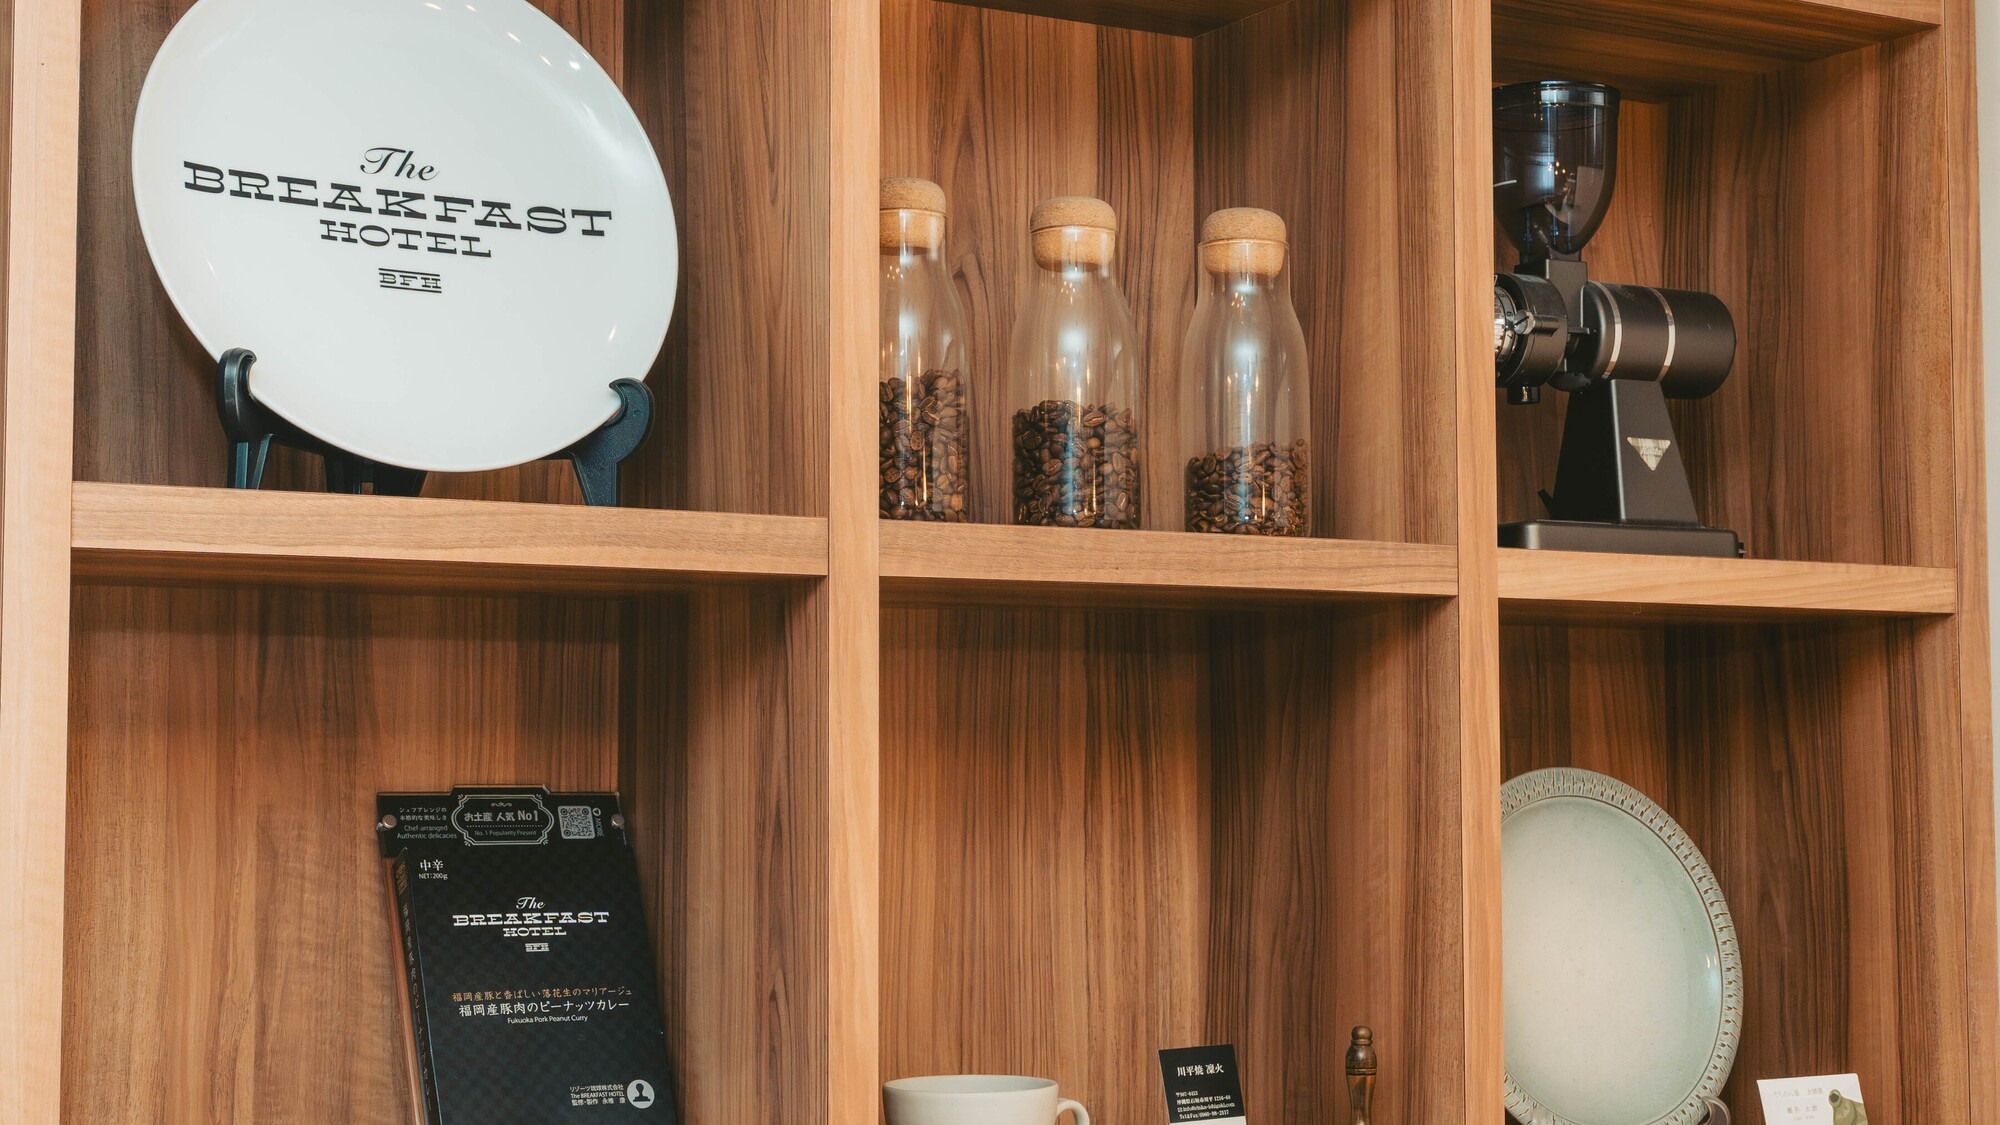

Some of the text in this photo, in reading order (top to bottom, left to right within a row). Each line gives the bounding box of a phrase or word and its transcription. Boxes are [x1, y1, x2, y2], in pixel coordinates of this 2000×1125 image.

[360, 146, 439, 181] The
[183, 160, 612, 237] BREAKFAST
[320, 218, 492, 258] HOTEL
[380, 270, 442, 291] BFH
[464, 812, 493, 822] お土産
[496, 812, 516, 822] 人気
[420, 859, 444, 871] 中辛
[516, 896, 546, 910] The
[452, 911, 610, 926] BREAKFAST
[502, 926, 567, 937] HOTEL
[452, 986, 633, 1002] 福岡産豚と香ばしい落花生のマリアージュ
[459, 999, 630, 1018] 福岡産豚肉のピーナッツカレー
[508, 1016, 534, 1024] Fukuoka
[571, 1014, 588, 1023] Curry
